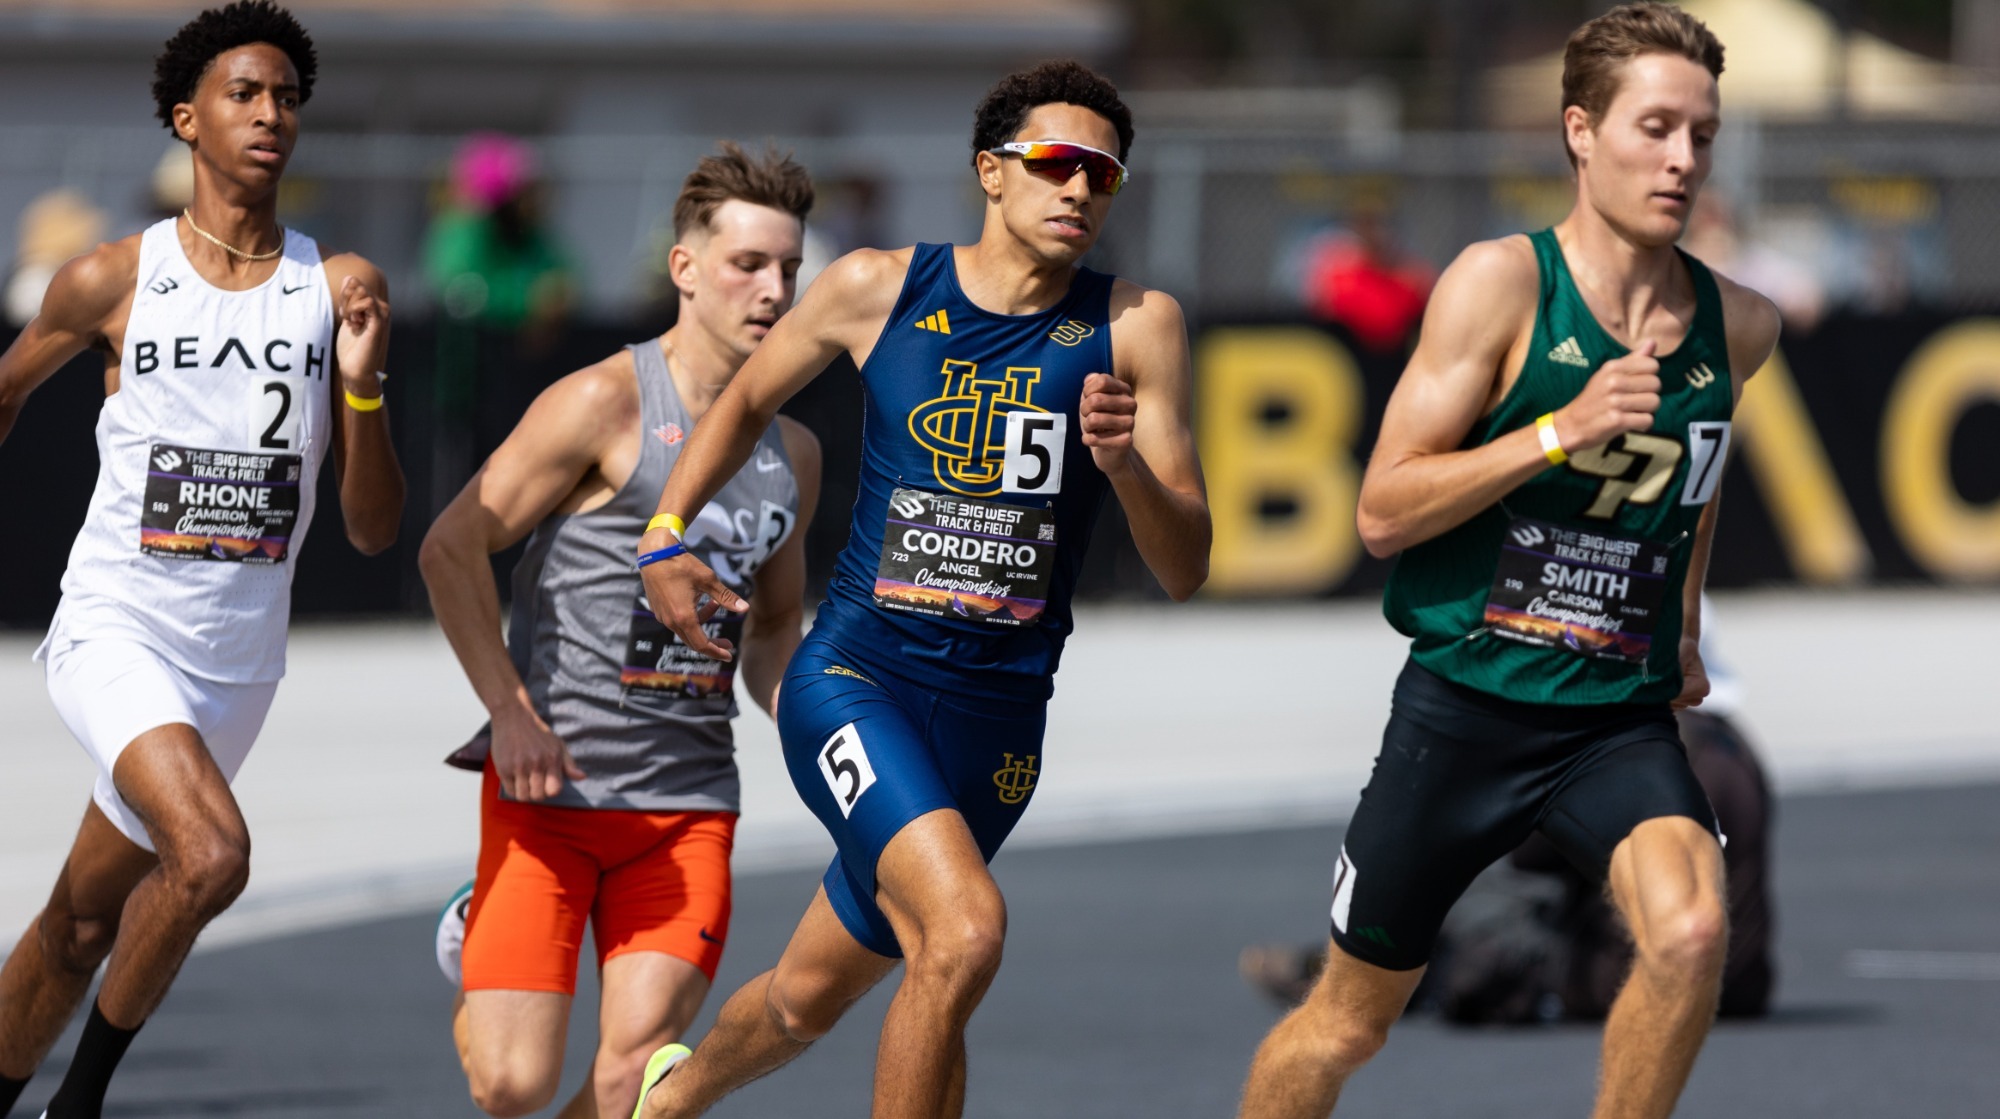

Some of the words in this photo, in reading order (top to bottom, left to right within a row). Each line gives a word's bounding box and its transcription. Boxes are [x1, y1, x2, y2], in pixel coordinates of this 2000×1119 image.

[135, 336, 325, 381] BEACH
[1548, 350, 1589, 367] adidas
[260, 381, 292, 449] 2
[185, 450, 212, 464] THE
[213, 453, 238, 467] BIG
[239, 456, 275, 470] WEST
[1017, 418, 1054, 490] 5
[1691, 428, 1724, 500] 7
[192, 464, 225, 478] TRACK
[228, 468, 237, 480] &
[237, 469, 265, 482] FIELD
[178, 481, 271, 509] RHONE
[186, 507, 249, 522] CAMERON
[929, 499, 957, 514] THE
[958, 503, 984, 519] BIG
[985, 509, 1024, 524] WEST
[175, 514, 266, 541] Championships
[935, 514, 970, 531] TRACK
[973, 521, 982, 533] &
[983, 523, 1013, 537] FIELD
[902, 529, 1037, 567] CORDERO
[1550, 528, 1577, 543] THE
[1578, 533, 1605, 550] BIG
[1605, 540, 1641, 557] WEST
[891, 551, 909, 563] 723
[938, 561, 982, 577] ANGEL
[1554, 543, 1589, 562] TRACK
[1591, 552, 1601, 564] &
[1601, 553, 1631, 570] FIELD
[914, 568, 1011, 599] Championships
[1006, 571, 1016, 579] UC
[1016, 572, 1038, 581] IRVINE
[1540, 562, 1630, 599] SMITH
[1547, 590, 1604, 611] CARSON
[1526, 596, 1624, 633] Championships
[824, 735, 860, 806] 5
